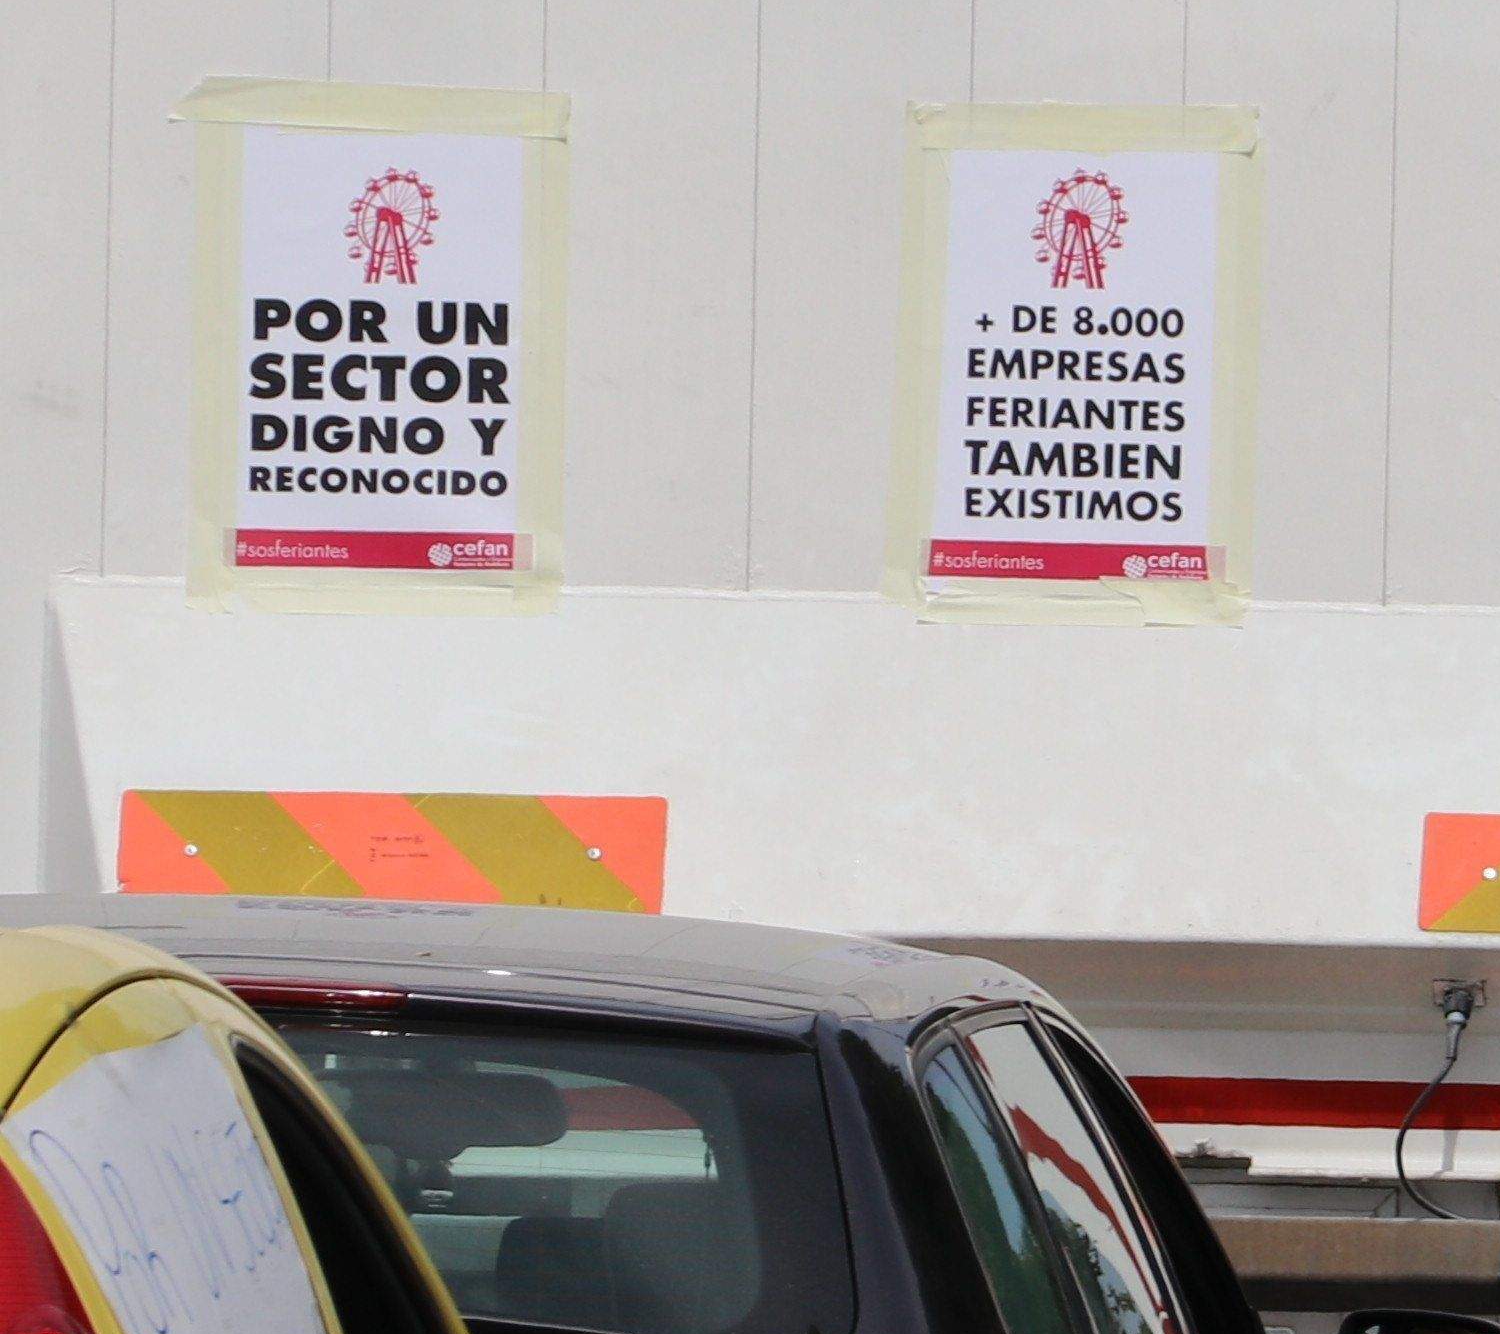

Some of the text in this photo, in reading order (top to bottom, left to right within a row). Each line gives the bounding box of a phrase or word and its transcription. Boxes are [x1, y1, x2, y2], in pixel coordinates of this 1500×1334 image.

[254, 298, 509, 346] POR UN
[1013, 305, 1056, 334] DE
[1073, 306, 1184, 338] 8.000
[249, 352, 509, 404] SECTOR
[968, 348, 1185, 384] EMPRESAS
[967, 396, 1185, 432] FERIANTES
[251, 413, 506, 456] DIGNO Y
[964, 440, 1181, 480] TAMBIEN
[250, 466, 508, 497] RECONOCIDO
[965, 487, 1182, 522] EXISTIMOS
[236, 539, 349, 559] #sosferiantes
[452, 540, 508, 555] cefan
[933, 551, 1044, 570] #sosferiantes
[1147, 552, 1201, 568] cefan
